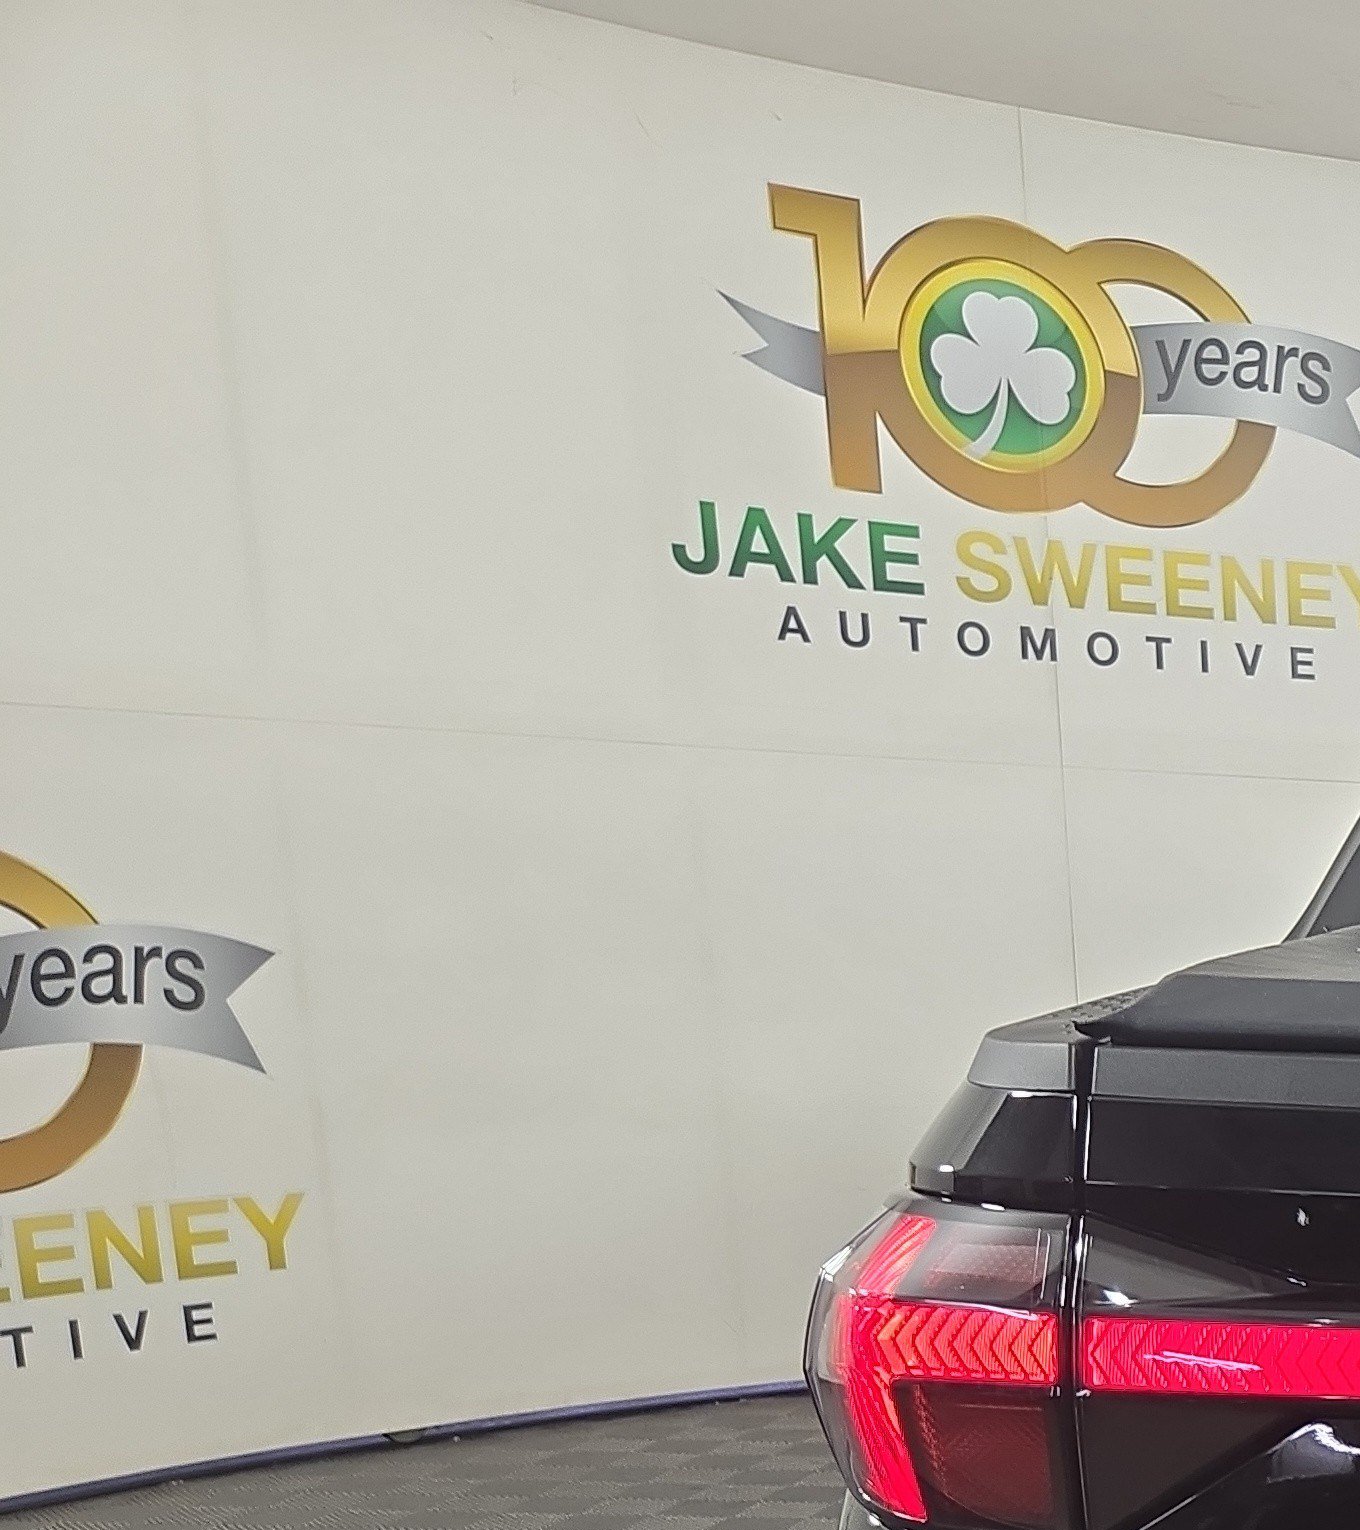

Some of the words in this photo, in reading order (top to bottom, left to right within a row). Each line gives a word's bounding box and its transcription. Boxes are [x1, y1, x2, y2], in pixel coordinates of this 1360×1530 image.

[767, 183, 1279, 528] 100
[1155, 332, 1334, 406] years
[671, 499, 926, 597] JAKE
[777, 605, 1317, 681] AUTOMOTIVE
[0, 1192, 304, 1301] ENEY
